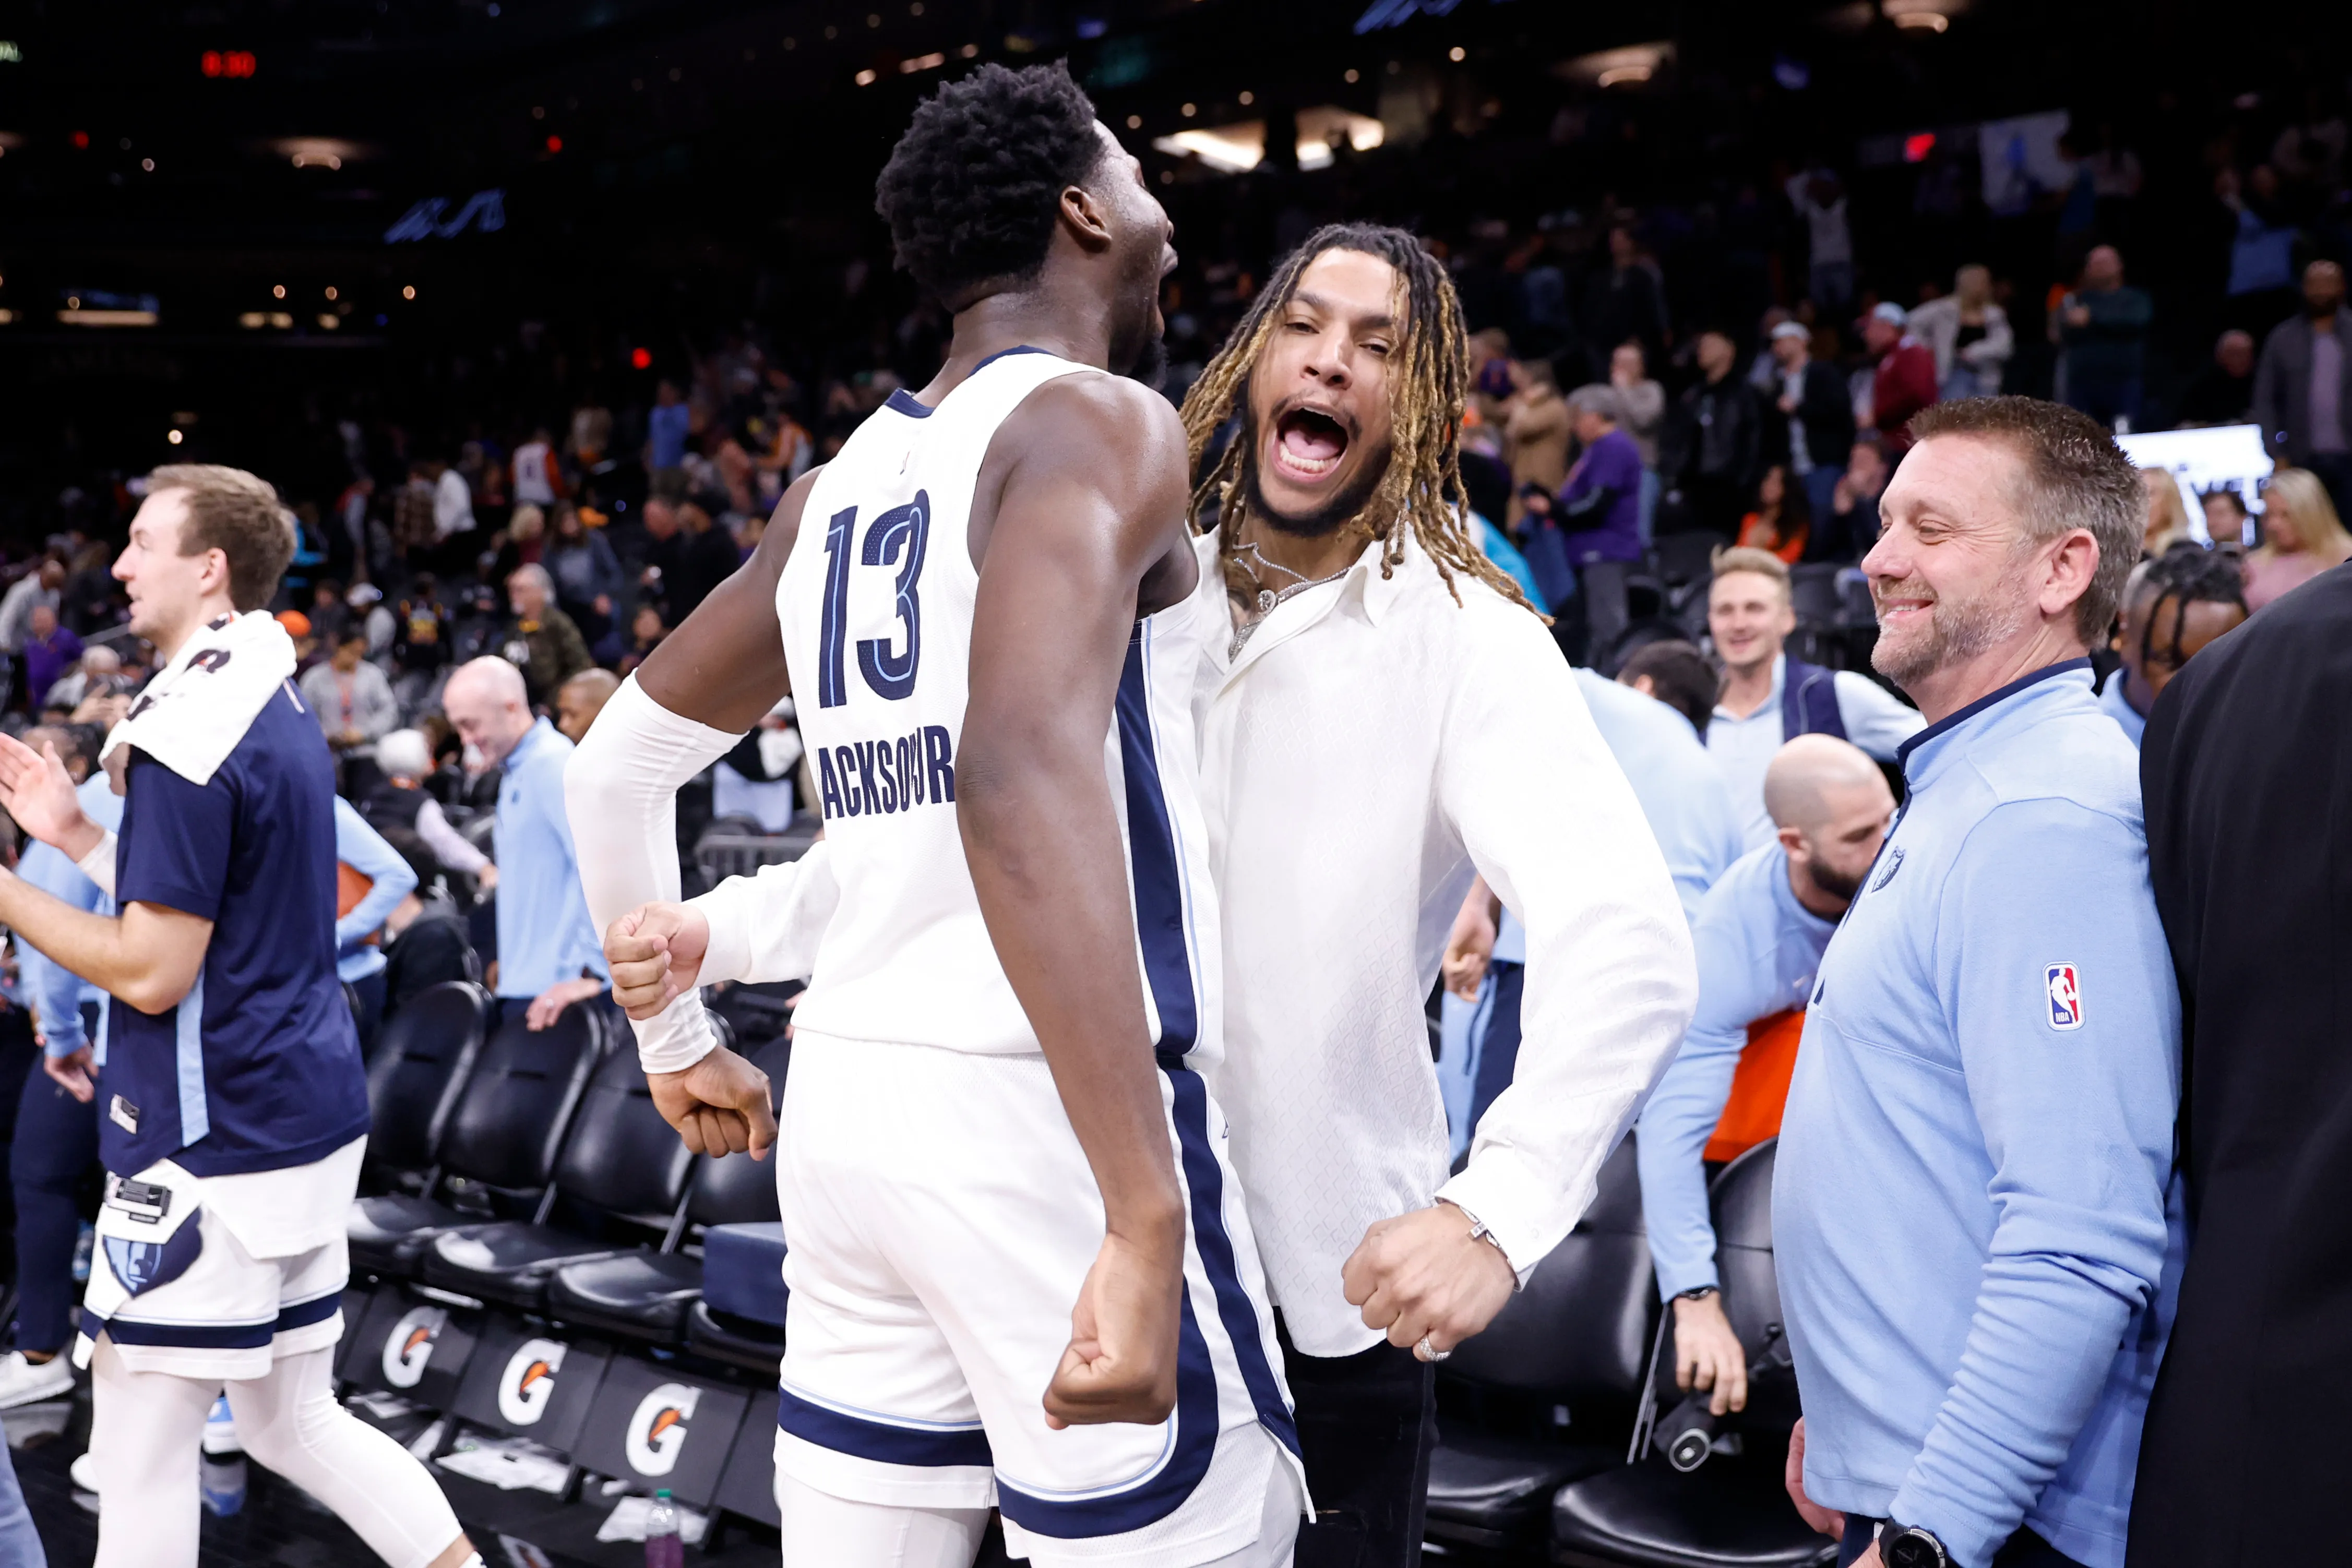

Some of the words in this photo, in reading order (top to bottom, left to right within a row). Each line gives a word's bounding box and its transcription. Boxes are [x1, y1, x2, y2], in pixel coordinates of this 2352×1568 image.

[818, 489, 930, 709] 13
[815, 733, 917, 820] ACKSO
[2055, 1011, 2070, 1023] NBA
[383, 1306, 448, 1388] G
[498, 1338, 567, 1426] G
[626, 1383, 702, 1477] G
